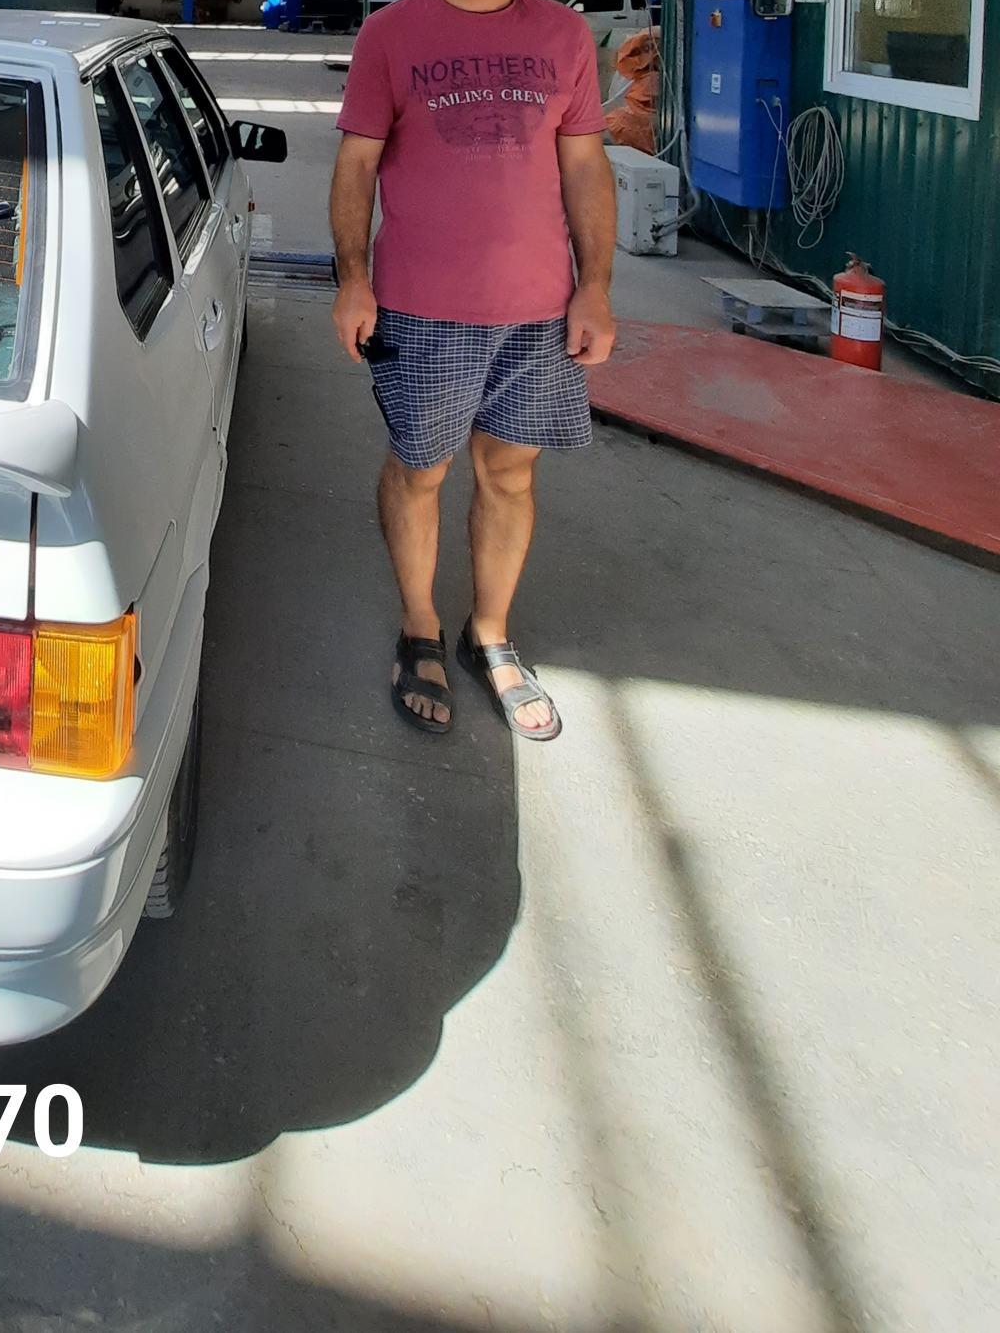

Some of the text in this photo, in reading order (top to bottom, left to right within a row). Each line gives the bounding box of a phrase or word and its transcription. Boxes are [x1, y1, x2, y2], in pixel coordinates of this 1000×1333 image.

[411, 57, 557, 90] NORTHERN
[427, 88, 494, 112] SAILING
[500, 88, 549, 105] CREW
